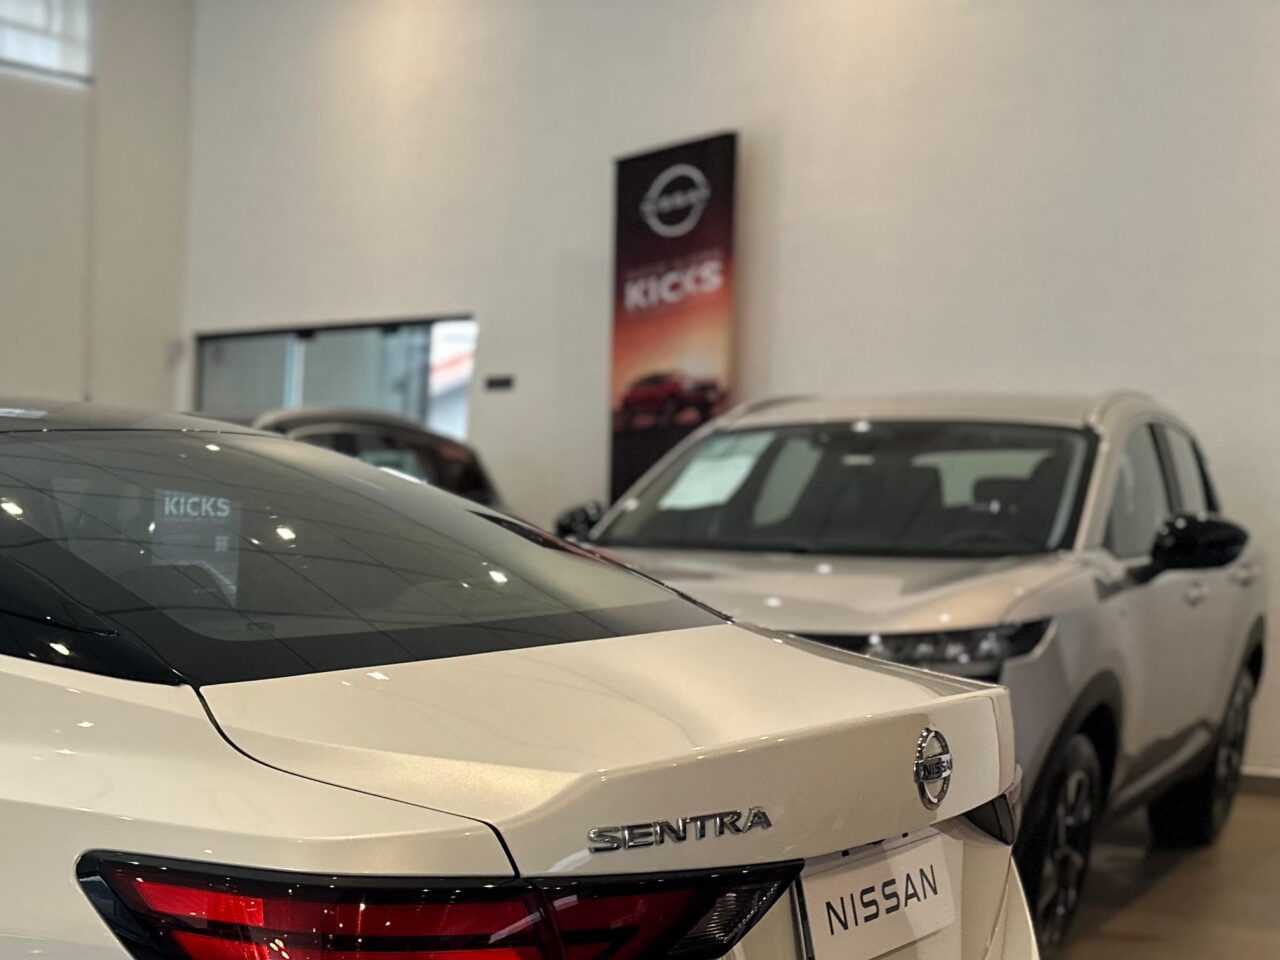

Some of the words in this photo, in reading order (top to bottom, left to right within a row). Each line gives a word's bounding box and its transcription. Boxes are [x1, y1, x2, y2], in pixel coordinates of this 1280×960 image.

[625, 260, 723, 311] KICKS
[165, 496, 230, 516] KICKS
[587, 806, 772, 854] SENTRA
[825, 864, 939, 936] NISSAN
